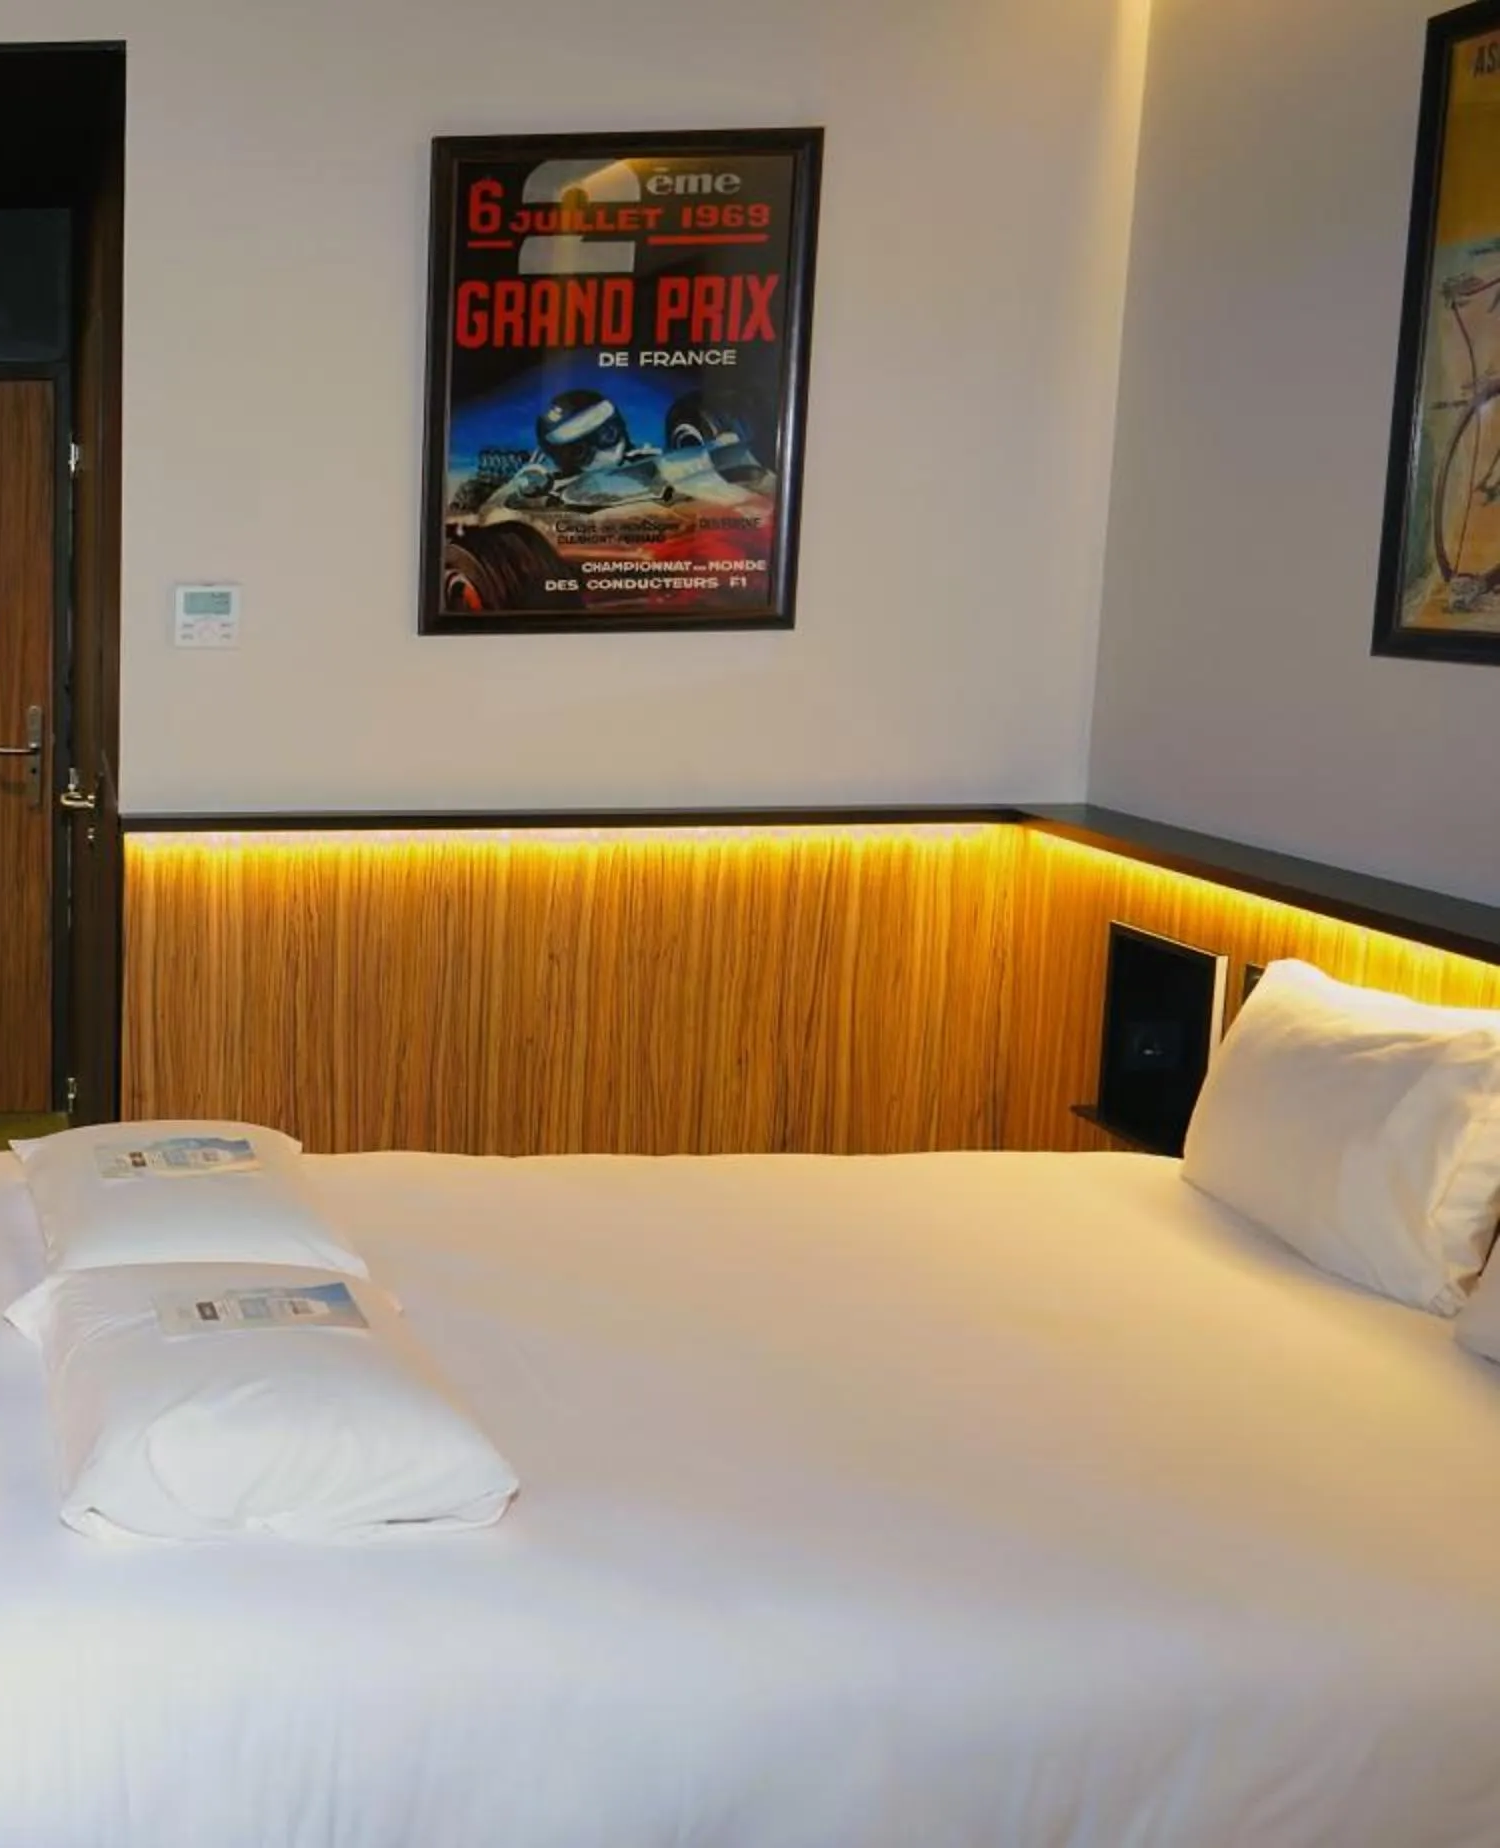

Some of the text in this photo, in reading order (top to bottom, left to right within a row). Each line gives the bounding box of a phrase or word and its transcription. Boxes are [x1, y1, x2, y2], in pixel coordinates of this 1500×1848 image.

[467, 178, 771, 234] 6 JUILLET 1969
[455, 274, 780, 349] GRAND PRIX
[598, 349, 738, 368] DE FRANCE
[581, 560, 693, 573] CHAMPIONNAT
[708, 559, 767, 572] MONDE
[545, 577, 748, 591] DES CONDUCTEURS F1
